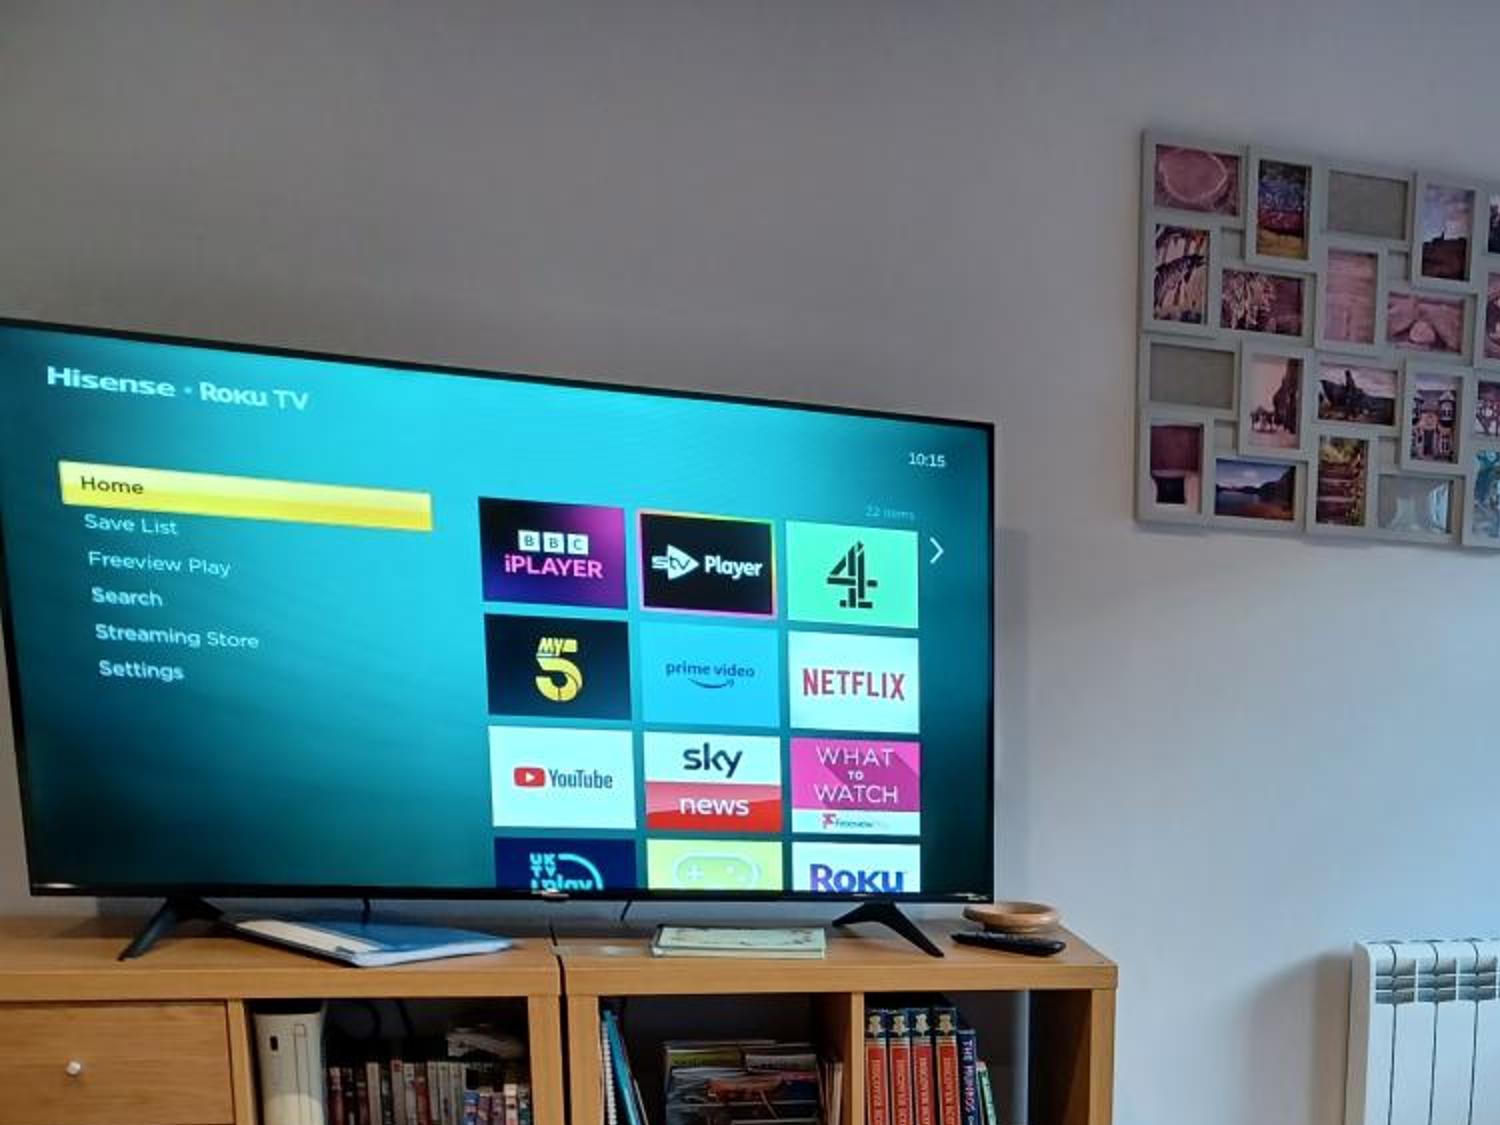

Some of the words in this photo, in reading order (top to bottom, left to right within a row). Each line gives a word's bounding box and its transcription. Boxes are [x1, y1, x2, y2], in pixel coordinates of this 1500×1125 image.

[47, 366, 177, 397] Hisense
[199, 381, 269, 407] Roku
[271, 389, 309, 411] TV
[908, 452, 946, 468] 10:15
[80, 475, 145, 495] Home
[84, 512, 136, 532] Save
[141, 517, 179, 535] List
[883, 508, 915, 521] items
[520, 532, 587, 553] BBC
[88, 551, 182, 572] Freeview
[188, 557, 231, 579] Play
[504, 554, 604, 579] iPLAYER
[704, 555, 763, 580] Player
[91, 586, 163, 607] Search
[95, 623, 200, 648] Streaming
[207, 631, 260, 648] Store
[99, 659, 185, 682] Settings
[665, 660, 711, 677] prime
[715, 663, 756, 678] video
[802, 667, 906, 701] NETFLIX
[683, 742, 743, 779] sky
[816, 745, 896, 767] WHAT
[549, 768, 614, 790] YouTube
[847, 770, 865, 781] TO
[813, 783, 899, 804] WATCH
[679, 796, 750, 817] news
